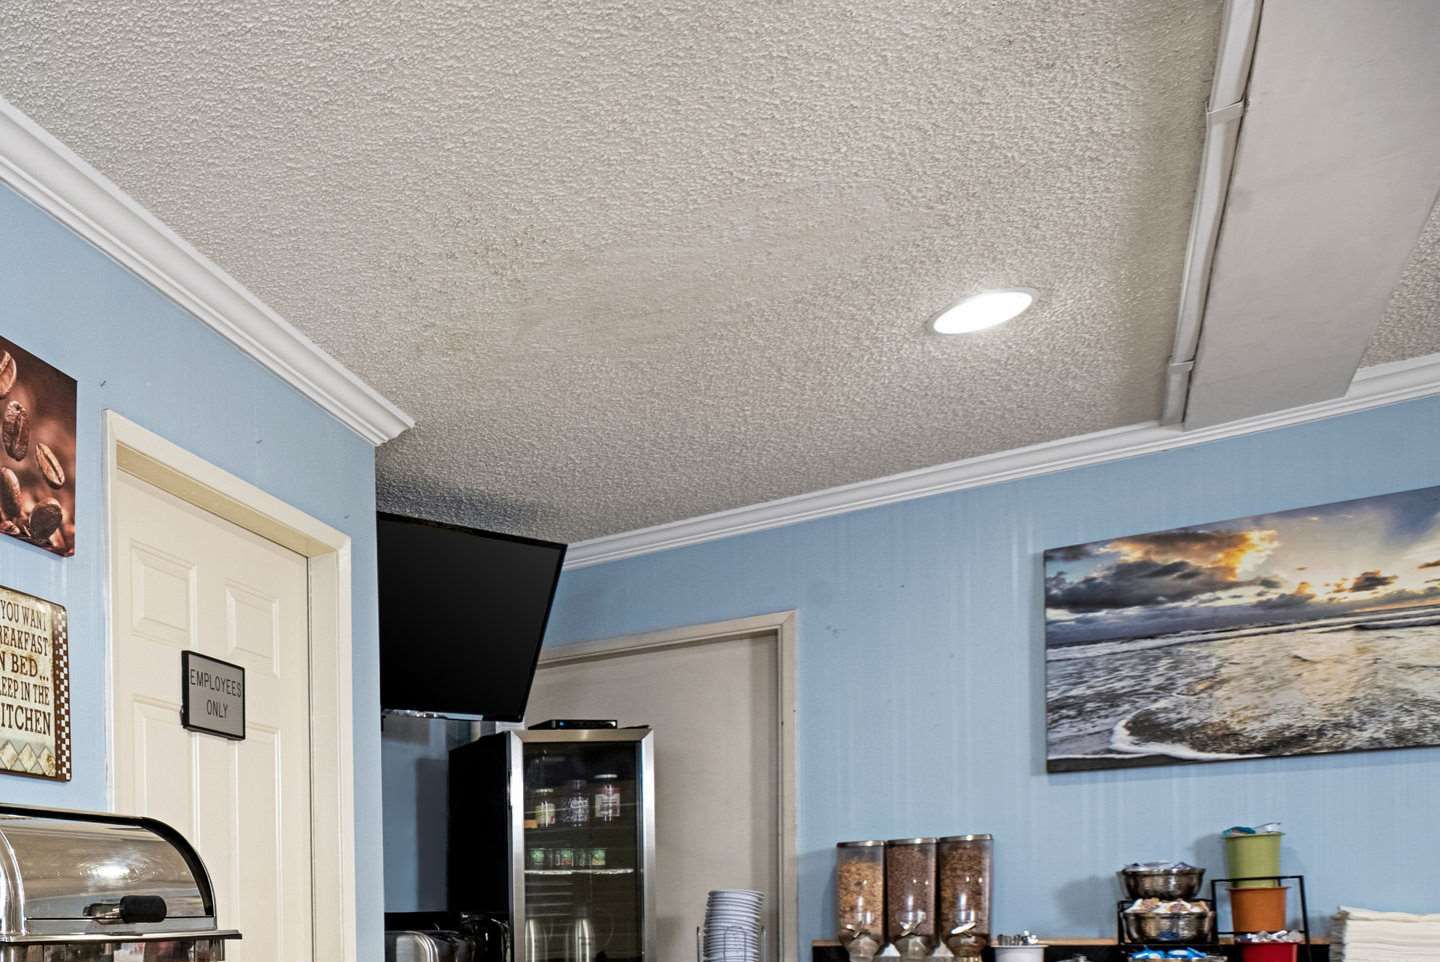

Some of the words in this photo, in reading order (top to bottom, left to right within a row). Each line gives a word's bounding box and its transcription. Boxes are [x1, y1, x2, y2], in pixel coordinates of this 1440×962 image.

[0, 599, 20, 623] YOU
[22, 604, 47, 632] WANT
[21, 682, 31, 703] IN
[33, 685, 50, 706] THE
[190, 668, 242, 698] EMPLOYEES
[206, 699, 228, 719] ONLY
